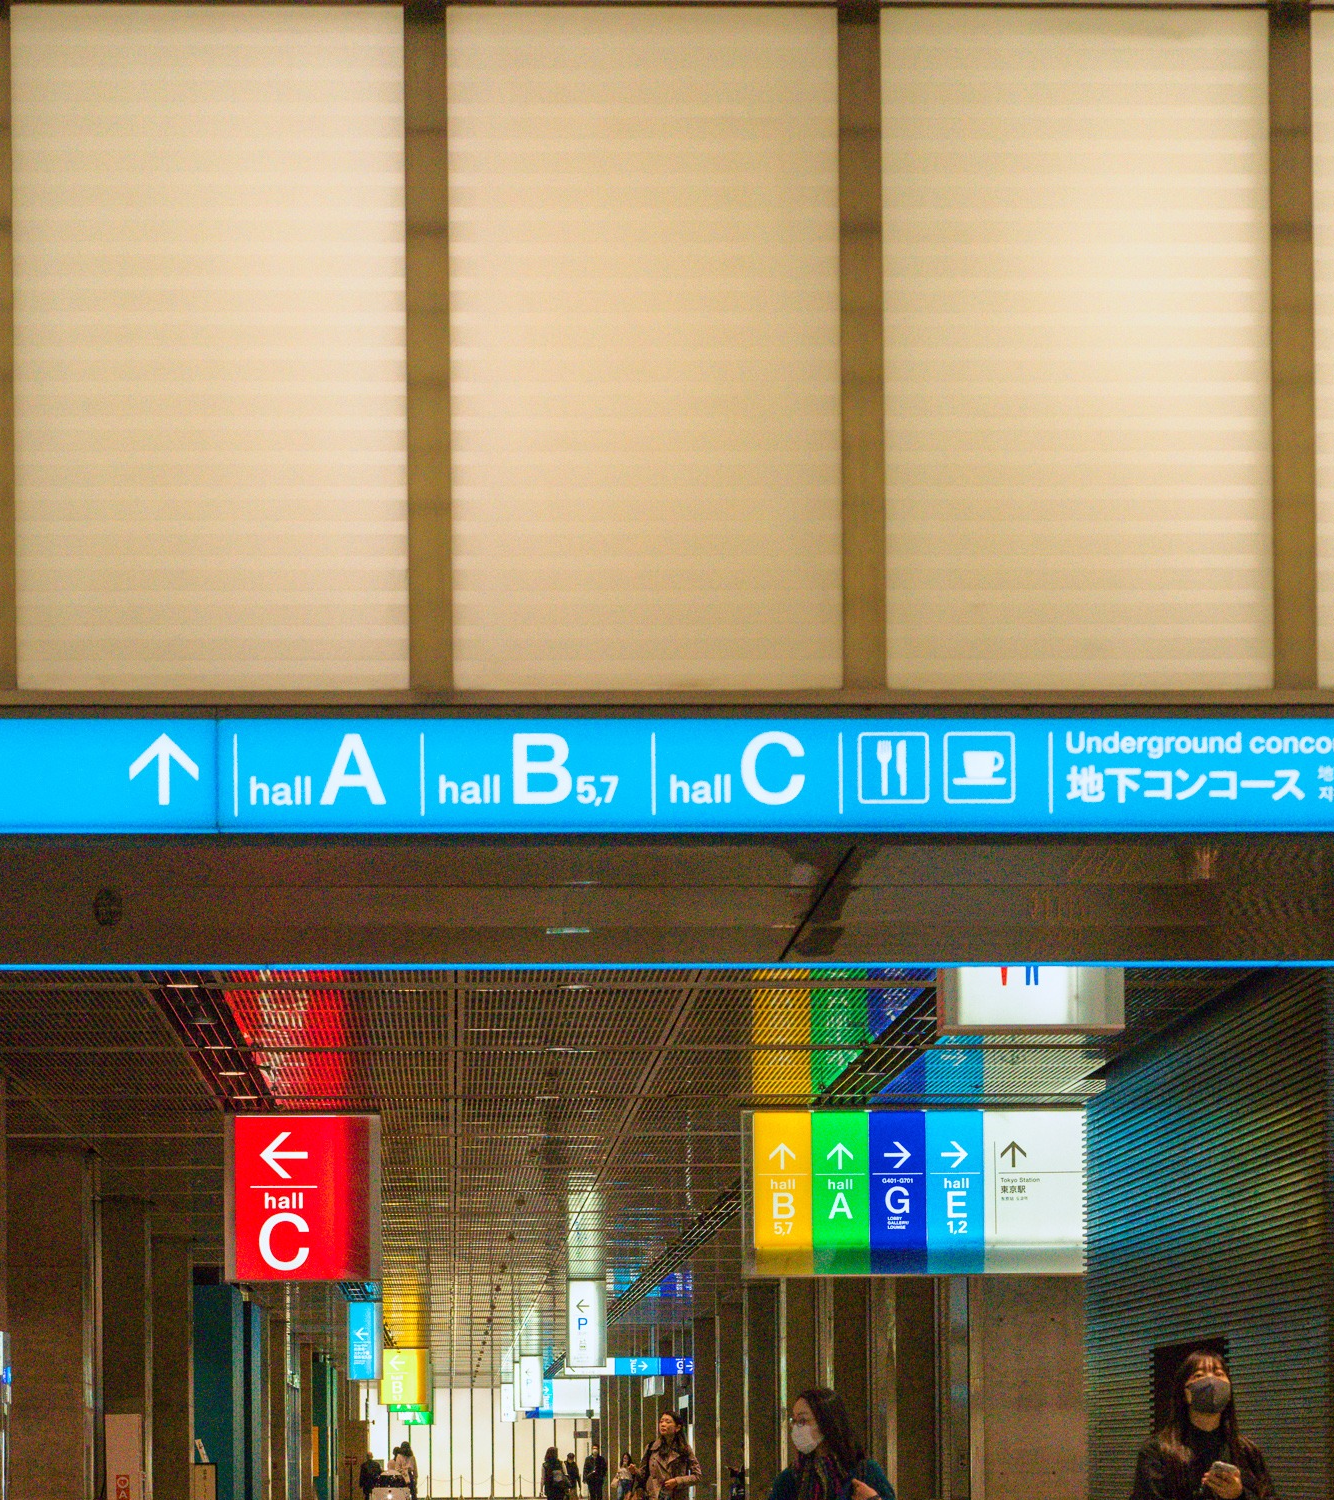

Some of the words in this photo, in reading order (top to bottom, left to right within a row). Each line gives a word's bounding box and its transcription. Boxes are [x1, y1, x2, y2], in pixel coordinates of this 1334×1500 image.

[1065, 731, 1243, 760] Underground
[249, 775, 312, 806] hall
[319, 733, 387, 806] A
[438, 774, 501, 805] hall
[512, 732, 573, 805] B
[576, 775, 619, 807] 5,7
[669, 773, 732, 804] hall
[740, 731, 806, 806] C
[1066, 764, 1306, 804] 地下コンコース
[770, 1178, 796, 1191] hall
[827, 1178, 853, 1191] hall
[943, 1177, 970, 1189] hall
[1000, 1185, 1026, 1194] 東京駅
[264, 1192, 304, 1210] hall
[772, 1192, 796, 1220] B
[828, 1192, 853, 1220] A
[884, 1185, 910, 1215] G
[946, 1190, 968, 1219] E
[258, 1212, 310, 1271] C
[773, 1221, 794, 1236] 5,7
[946, 1220, 968, 1235] 1,2
[577, 1317, 588, 1331] P
[392, 1381, 403, 1394] B
